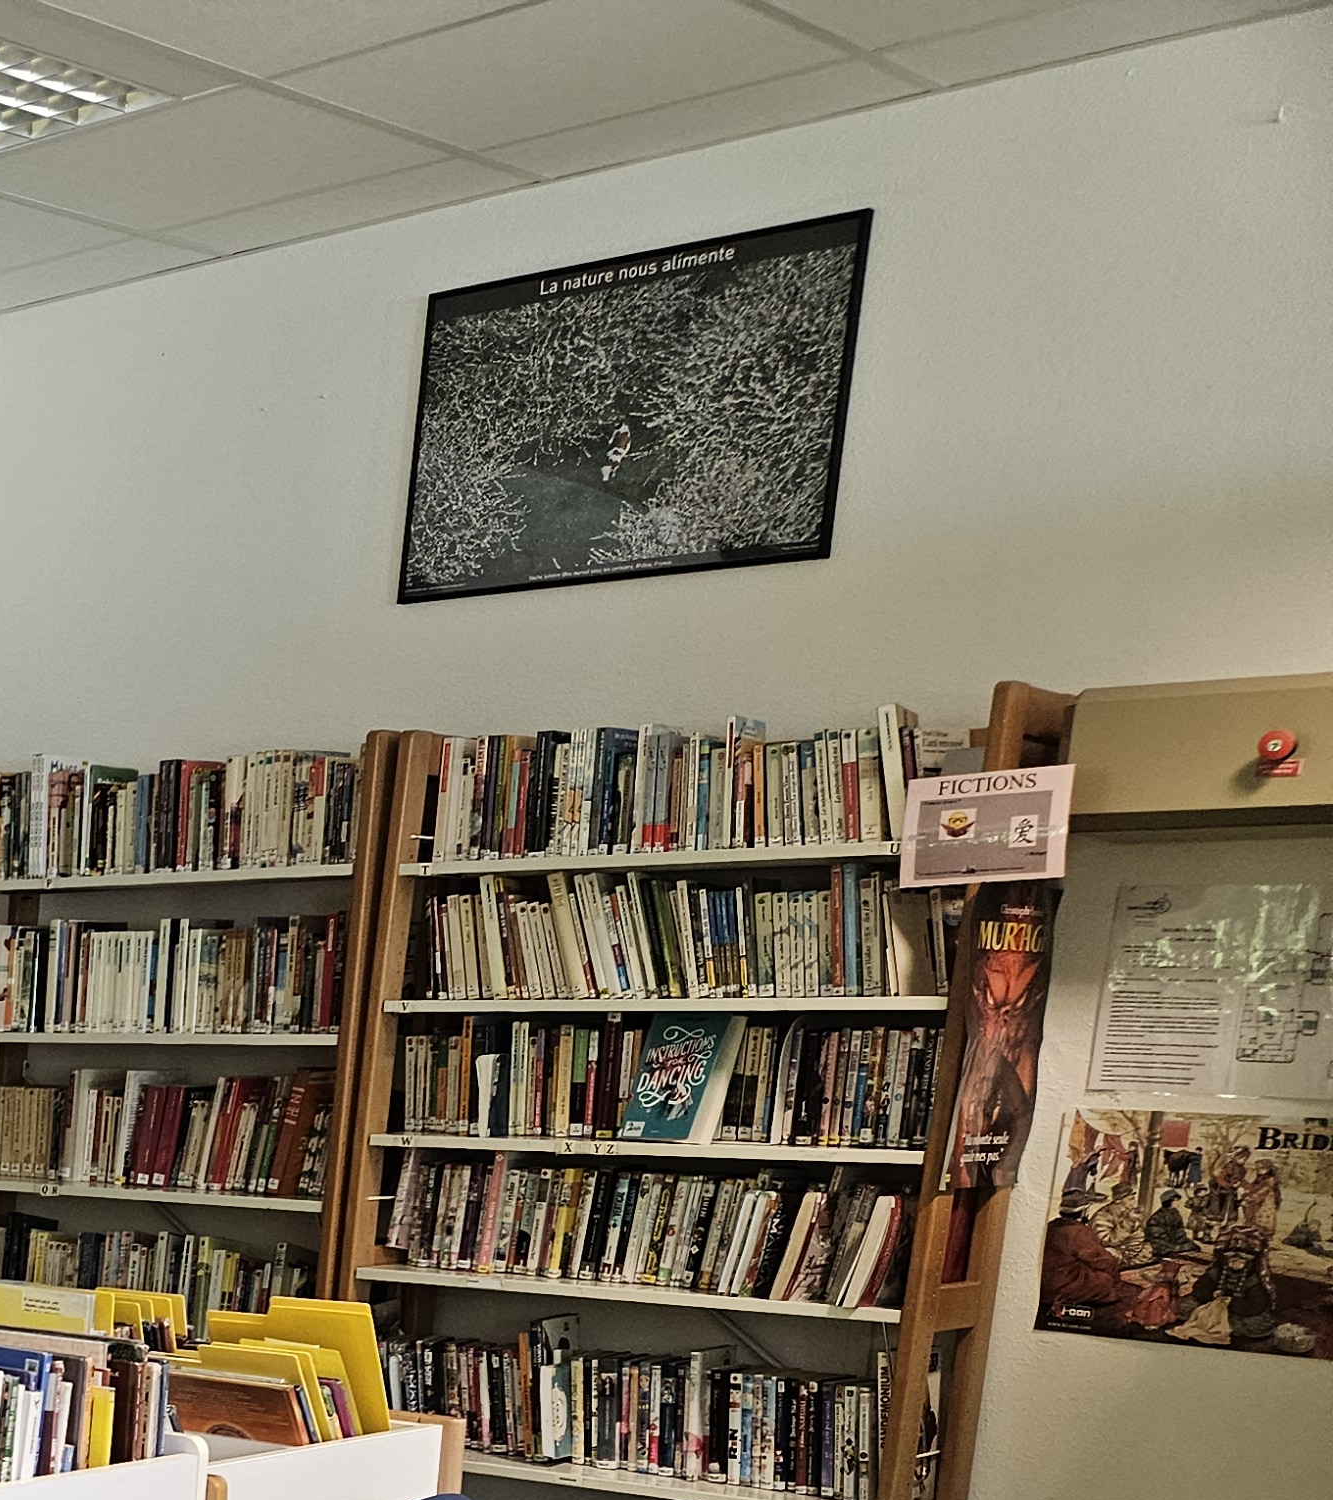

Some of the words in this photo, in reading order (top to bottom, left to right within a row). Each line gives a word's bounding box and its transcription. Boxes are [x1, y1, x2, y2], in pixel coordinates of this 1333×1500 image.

[539, 280, 558, 296] La
[562, 269, 614, 291] nature
[617, 261, 658, 281] nous
[661, 245, 736, 273] alimente
[937, 773, 1037, 796] FICTIONS
[646, 1034, 716, 1064] INSTRUCTIONS
[637, 1059, 708, 1094] DANCING
[1254, 1126, 1333, 1151] BRID
